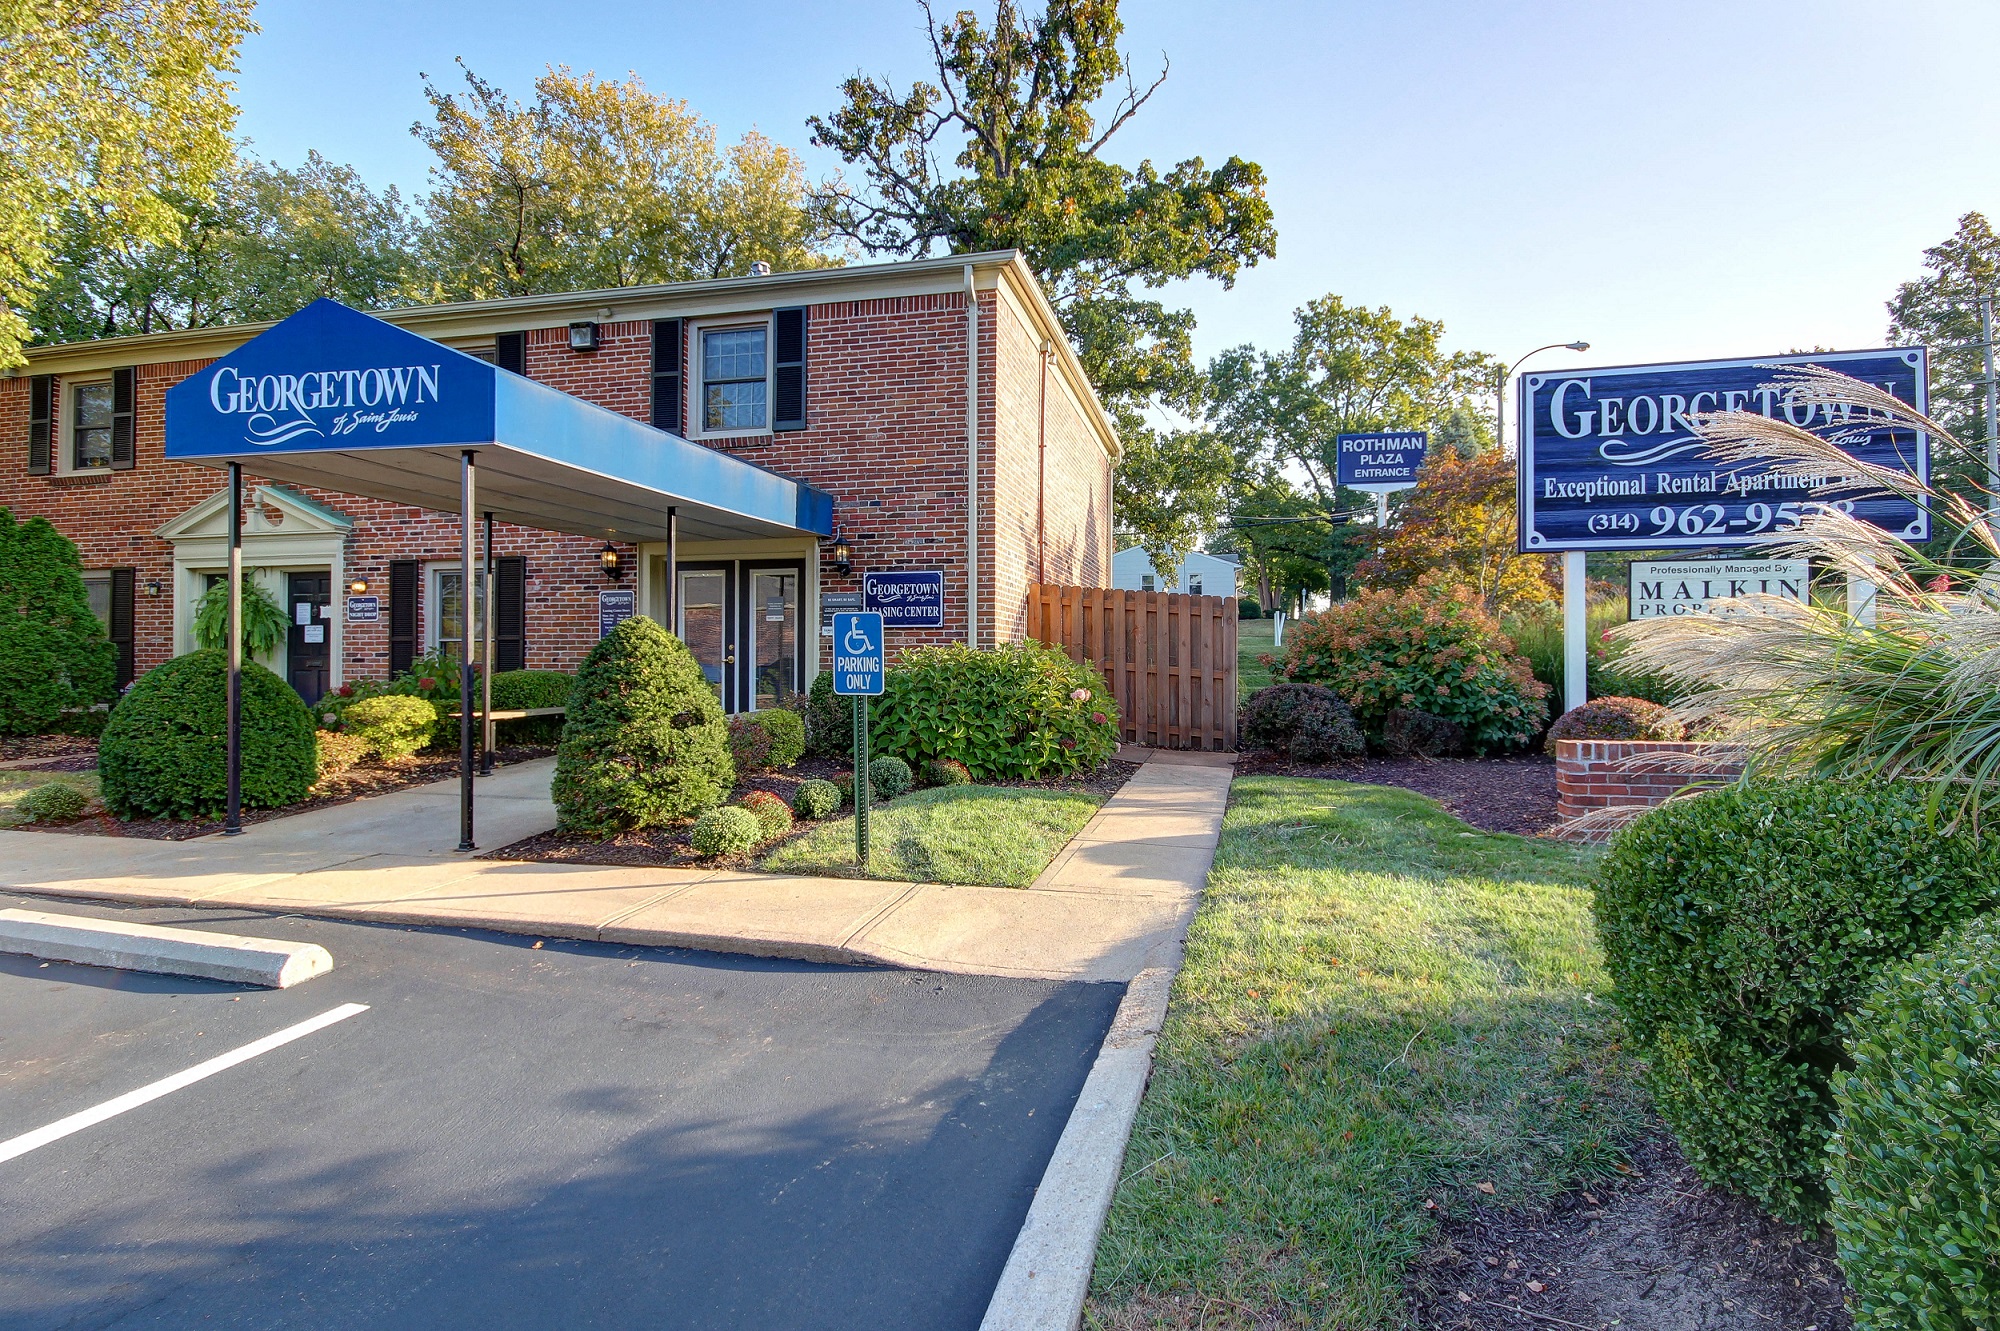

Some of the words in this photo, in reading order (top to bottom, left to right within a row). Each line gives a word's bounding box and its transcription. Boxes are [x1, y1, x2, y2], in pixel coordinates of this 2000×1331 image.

[210, 364, 441, 420] GEORGETOWN
[331, 412, 348, 435] of
[342, 410, 385, 435] Saint
[375, 407, 419, 433] Louis
[1342, 437, 1423, 452] ROTHMAN
[1360, 453, 1404, 465] PLAZA
[1354, 467, 1411, 478] ENTRANCE
[1543, 473, 1646, 503] Exceptional
[1656, 470, 1717, 494] Rental
[1587, 513, 1640, 533] (314)
[1650, 565, 1722, 574] Professionally
[1725, 564, 1771, 574] Managed
[1774, 564, 1792, 573] By:
[866, 579, 939, 595] GEORGETOWN
[1639, 579, 1801, 600] MALKIN
[904, 606, 939, 617] CENTER
[837, 656, 880, 673] PARKING
[846, 674, 871, 690] ONLY
